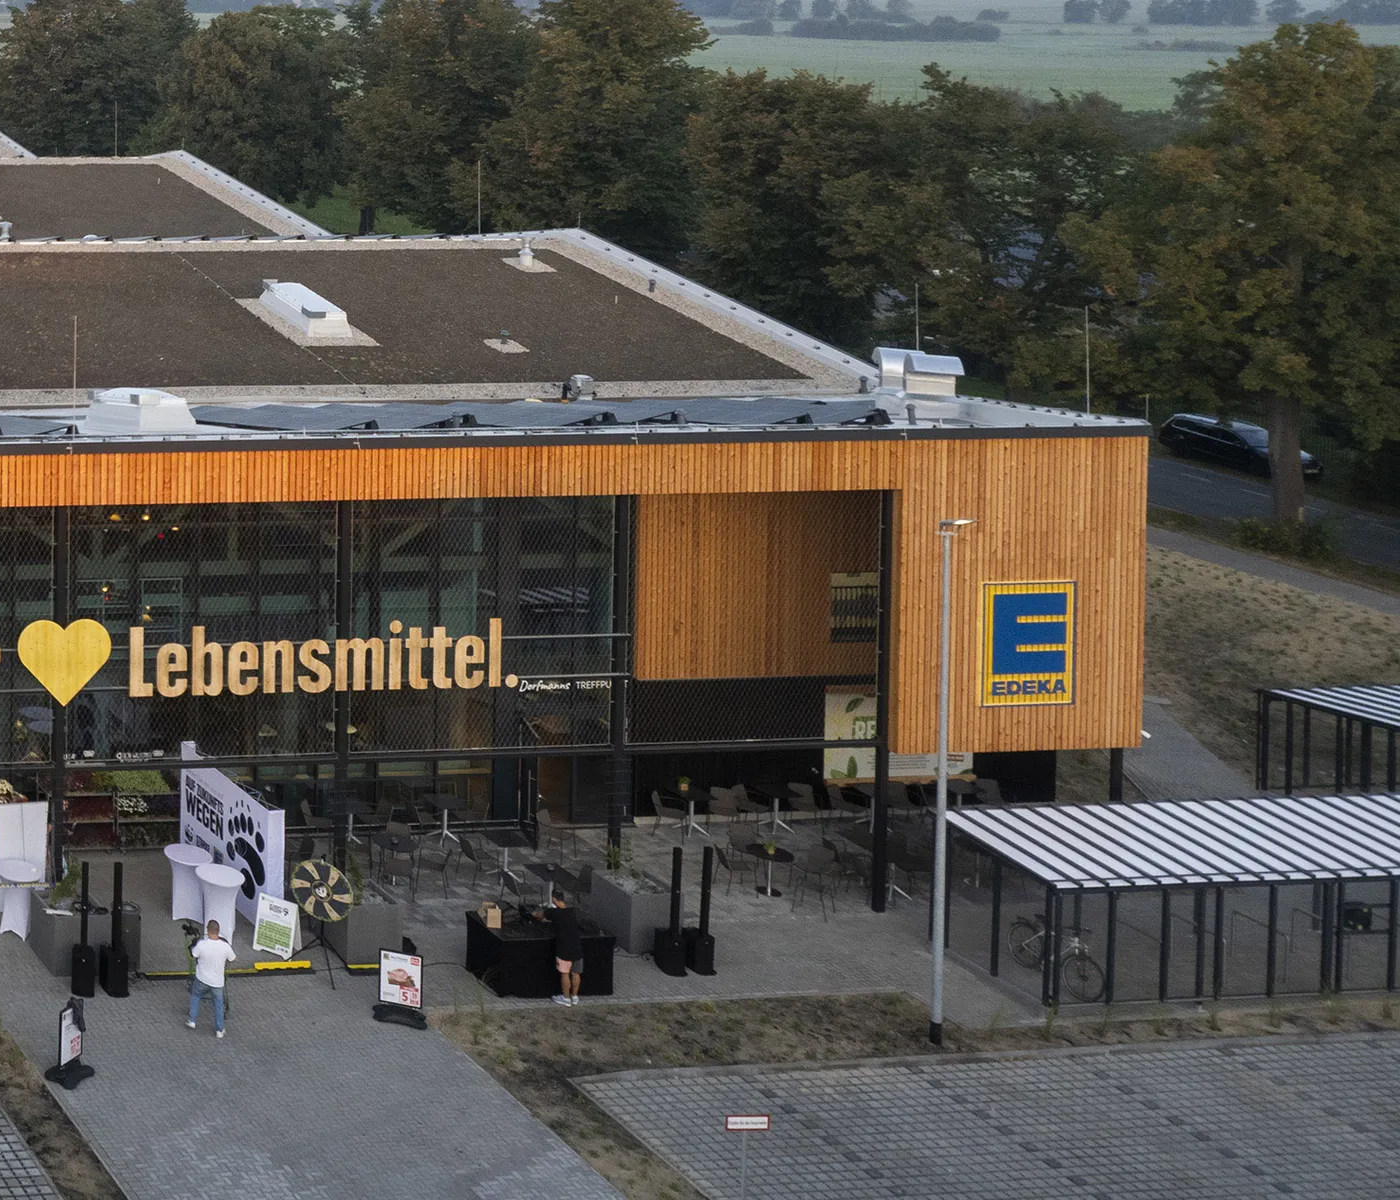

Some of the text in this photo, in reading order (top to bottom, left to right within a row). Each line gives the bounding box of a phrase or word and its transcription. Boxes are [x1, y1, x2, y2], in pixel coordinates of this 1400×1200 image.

[992, 592, 1067, 675] E
[129, 618, 519, 698] Lebensmittel.
[519, 680, 629, 692] Dorfmanns TREFFPUT
[991, 679, 1067, 697] EDEKA
[185, 788, 224, 841] WEGEN
[402, 991, 409, 1002] 5
